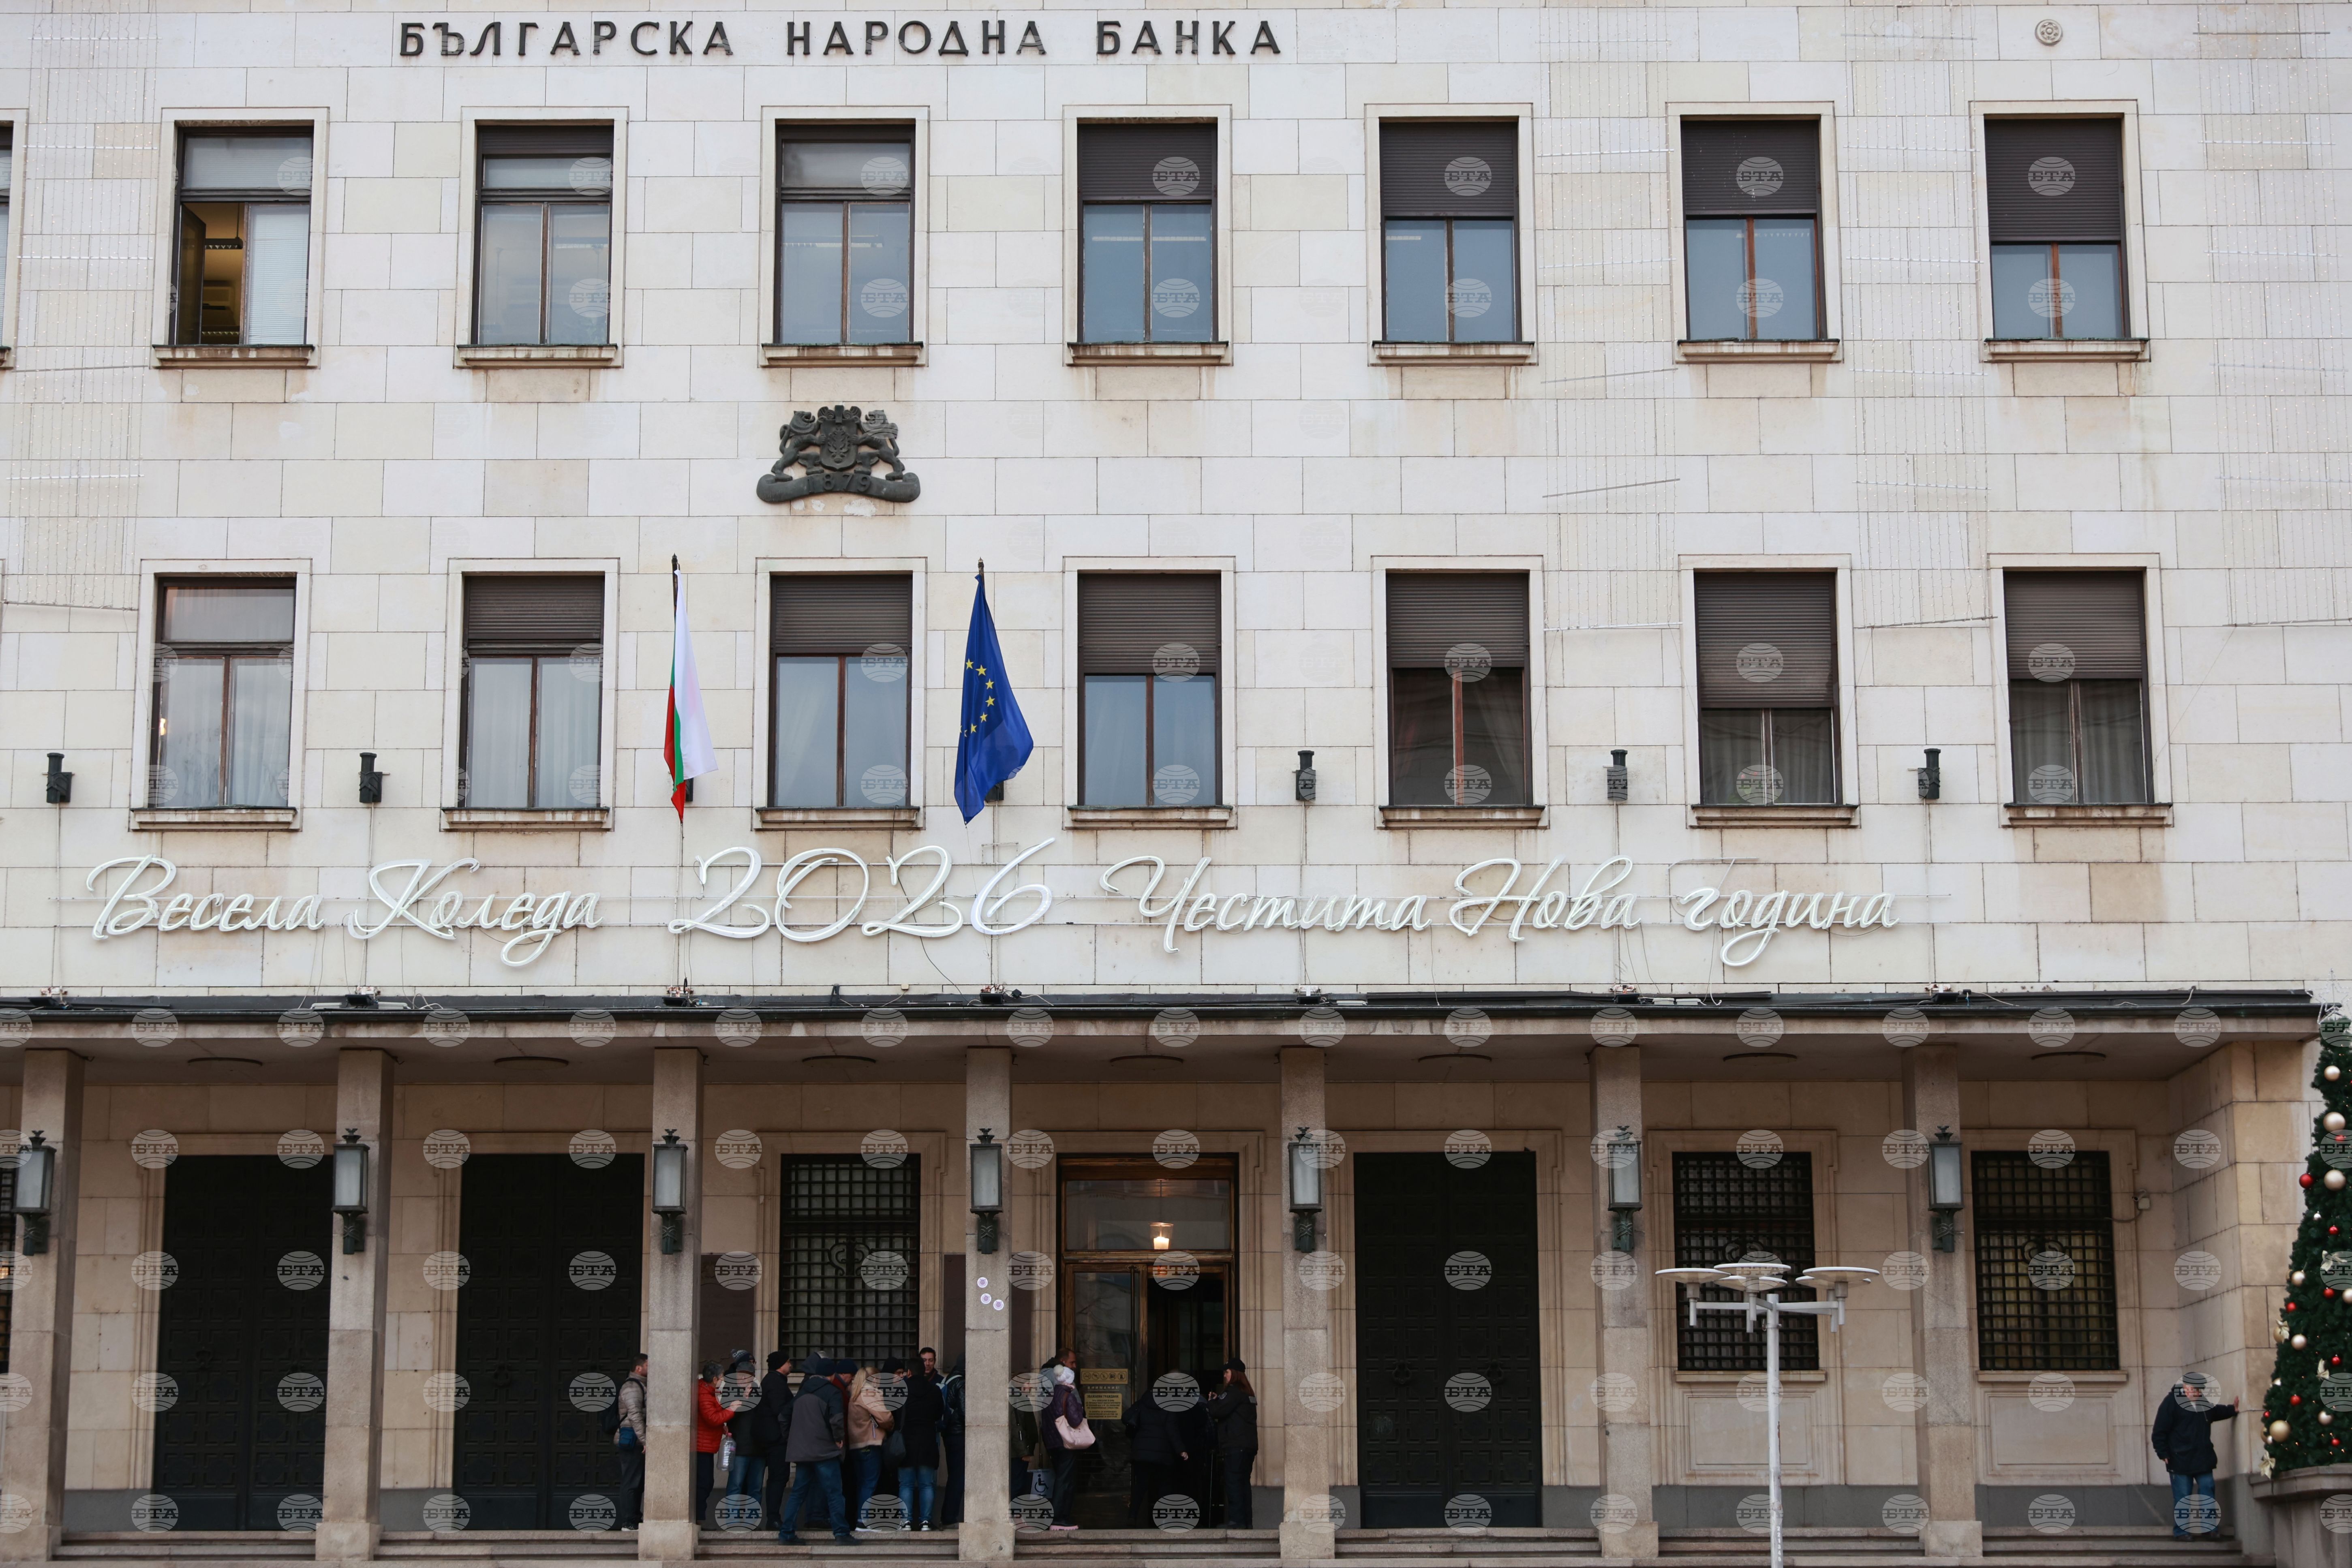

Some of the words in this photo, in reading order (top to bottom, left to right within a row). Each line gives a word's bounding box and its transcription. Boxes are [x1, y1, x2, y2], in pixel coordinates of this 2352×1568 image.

[400, 21, 733, 56] БЪЛГАРСКА
[788, 21, 1046, 56] НАРОДНА
[1096, 21, 1281, 55] БАНКА
[808, 473, 871, 493] 1879
[86, 854, 326, 941] Весела
[347, 857, 604, 967] Коледа
[667, 837, 1055, 942] 2026
[1099, 856, 1434, 954] Честита
[1449, 854, 1642, 943] Нова
